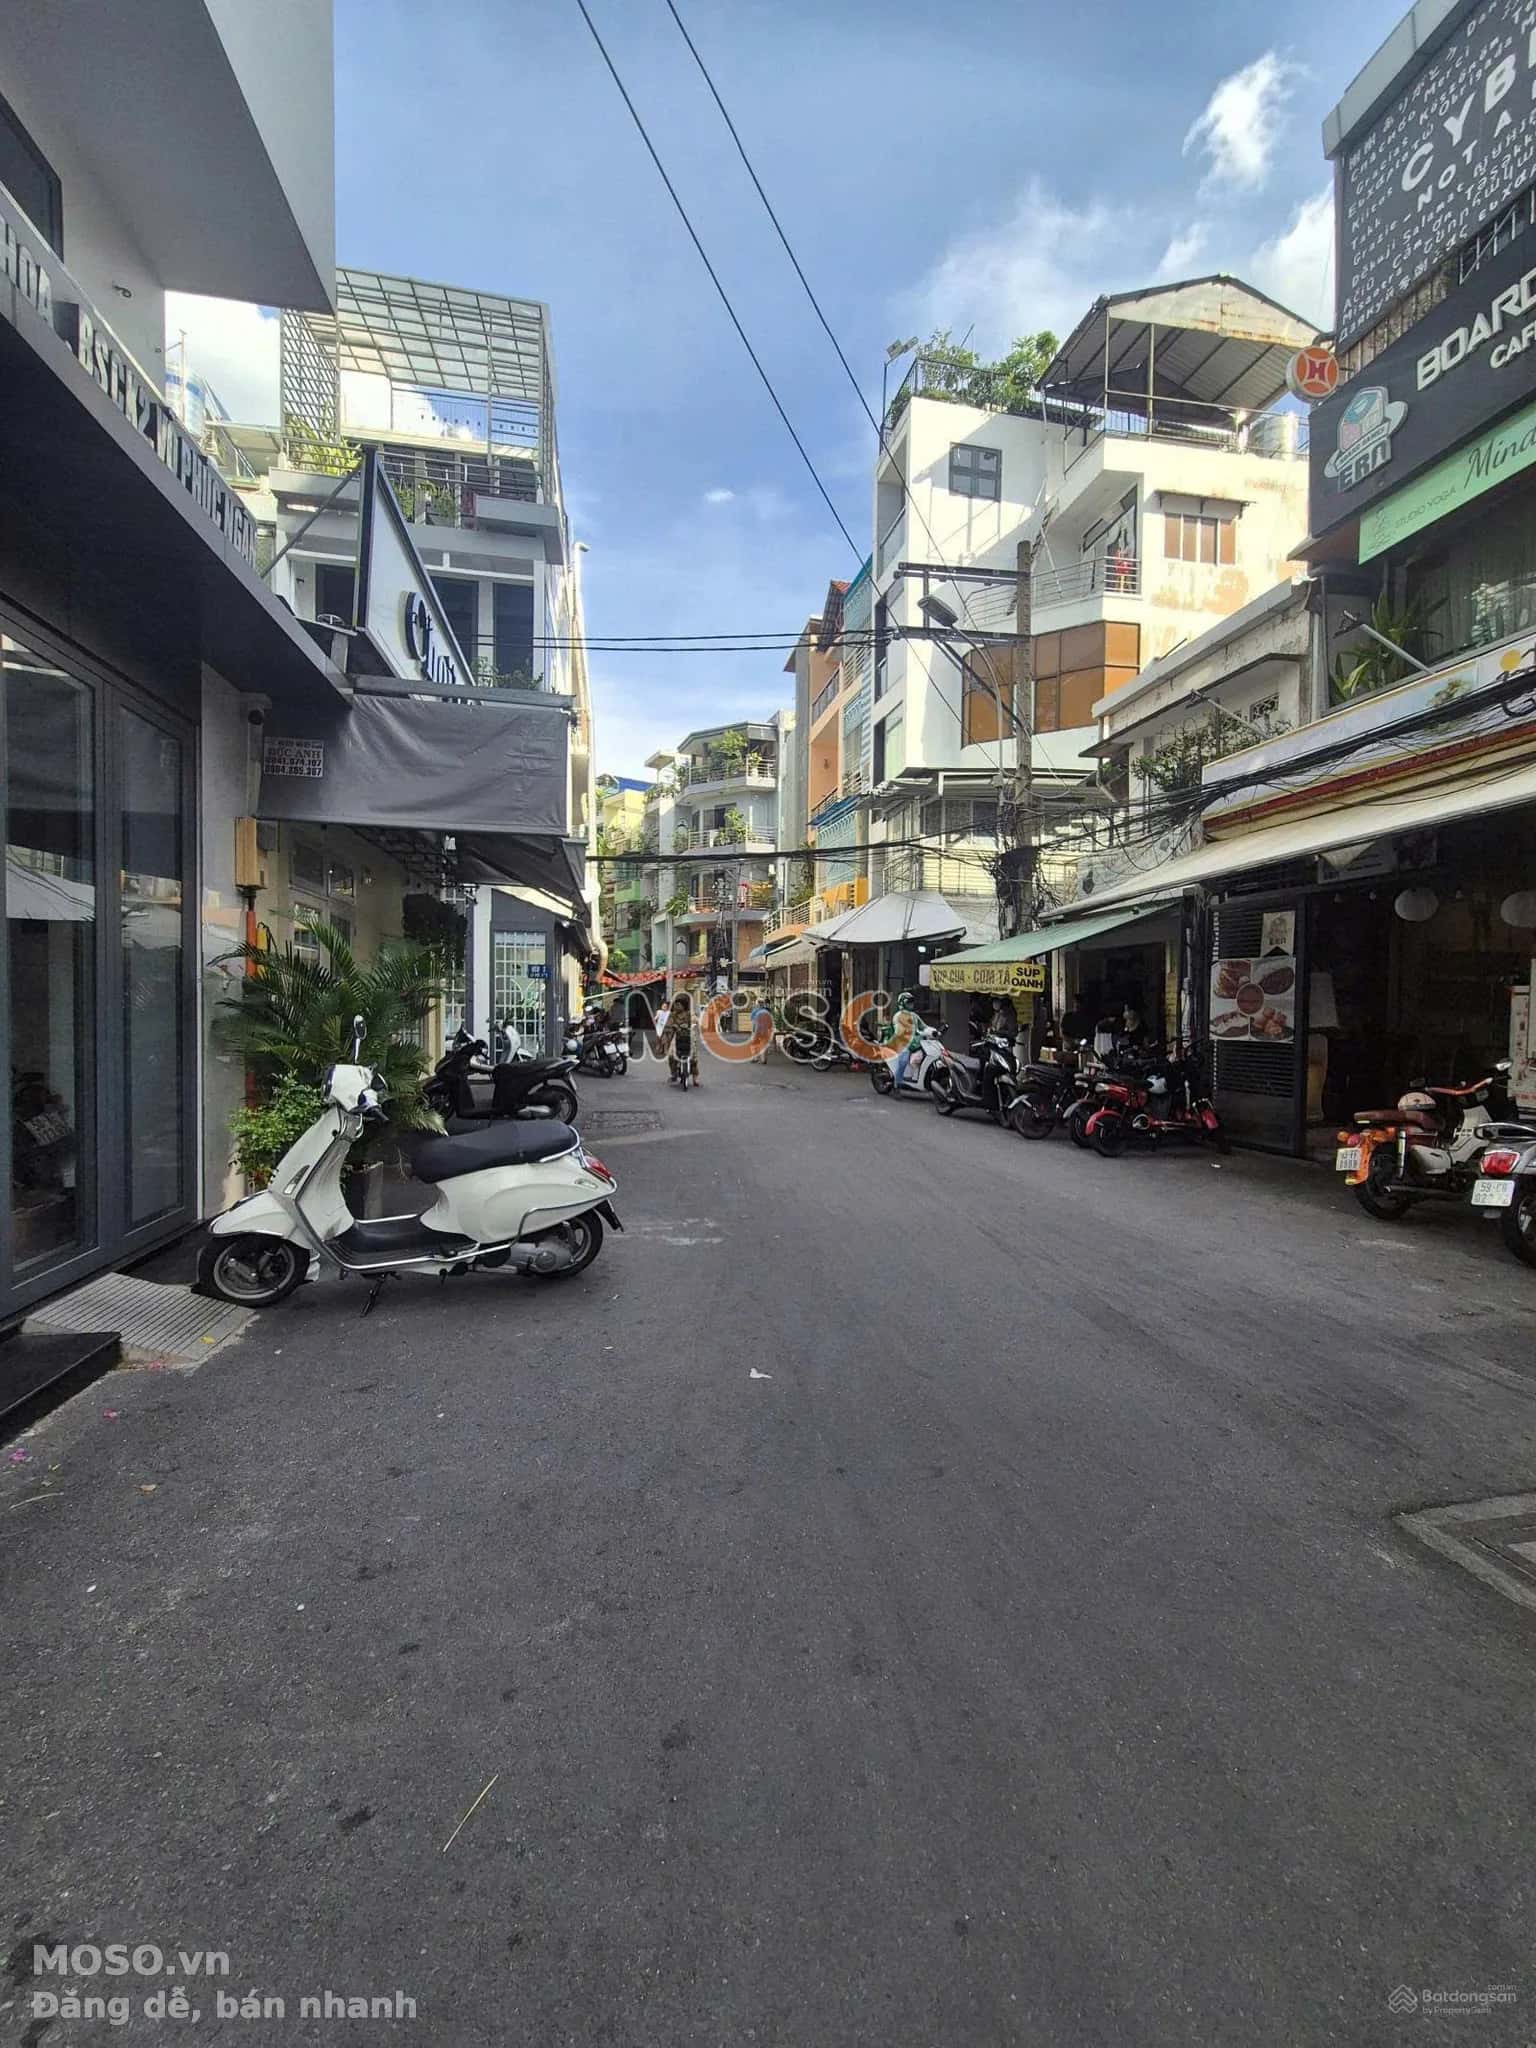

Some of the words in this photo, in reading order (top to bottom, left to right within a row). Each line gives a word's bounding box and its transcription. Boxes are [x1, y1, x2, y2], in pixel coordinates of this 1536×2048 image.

[1402, 27, 1536, 191] CYB
[1417, 139, 1478, 212] NOT
[1493, 110, 1512, 138] A
[1011, 977, 1043, 989] OANH
